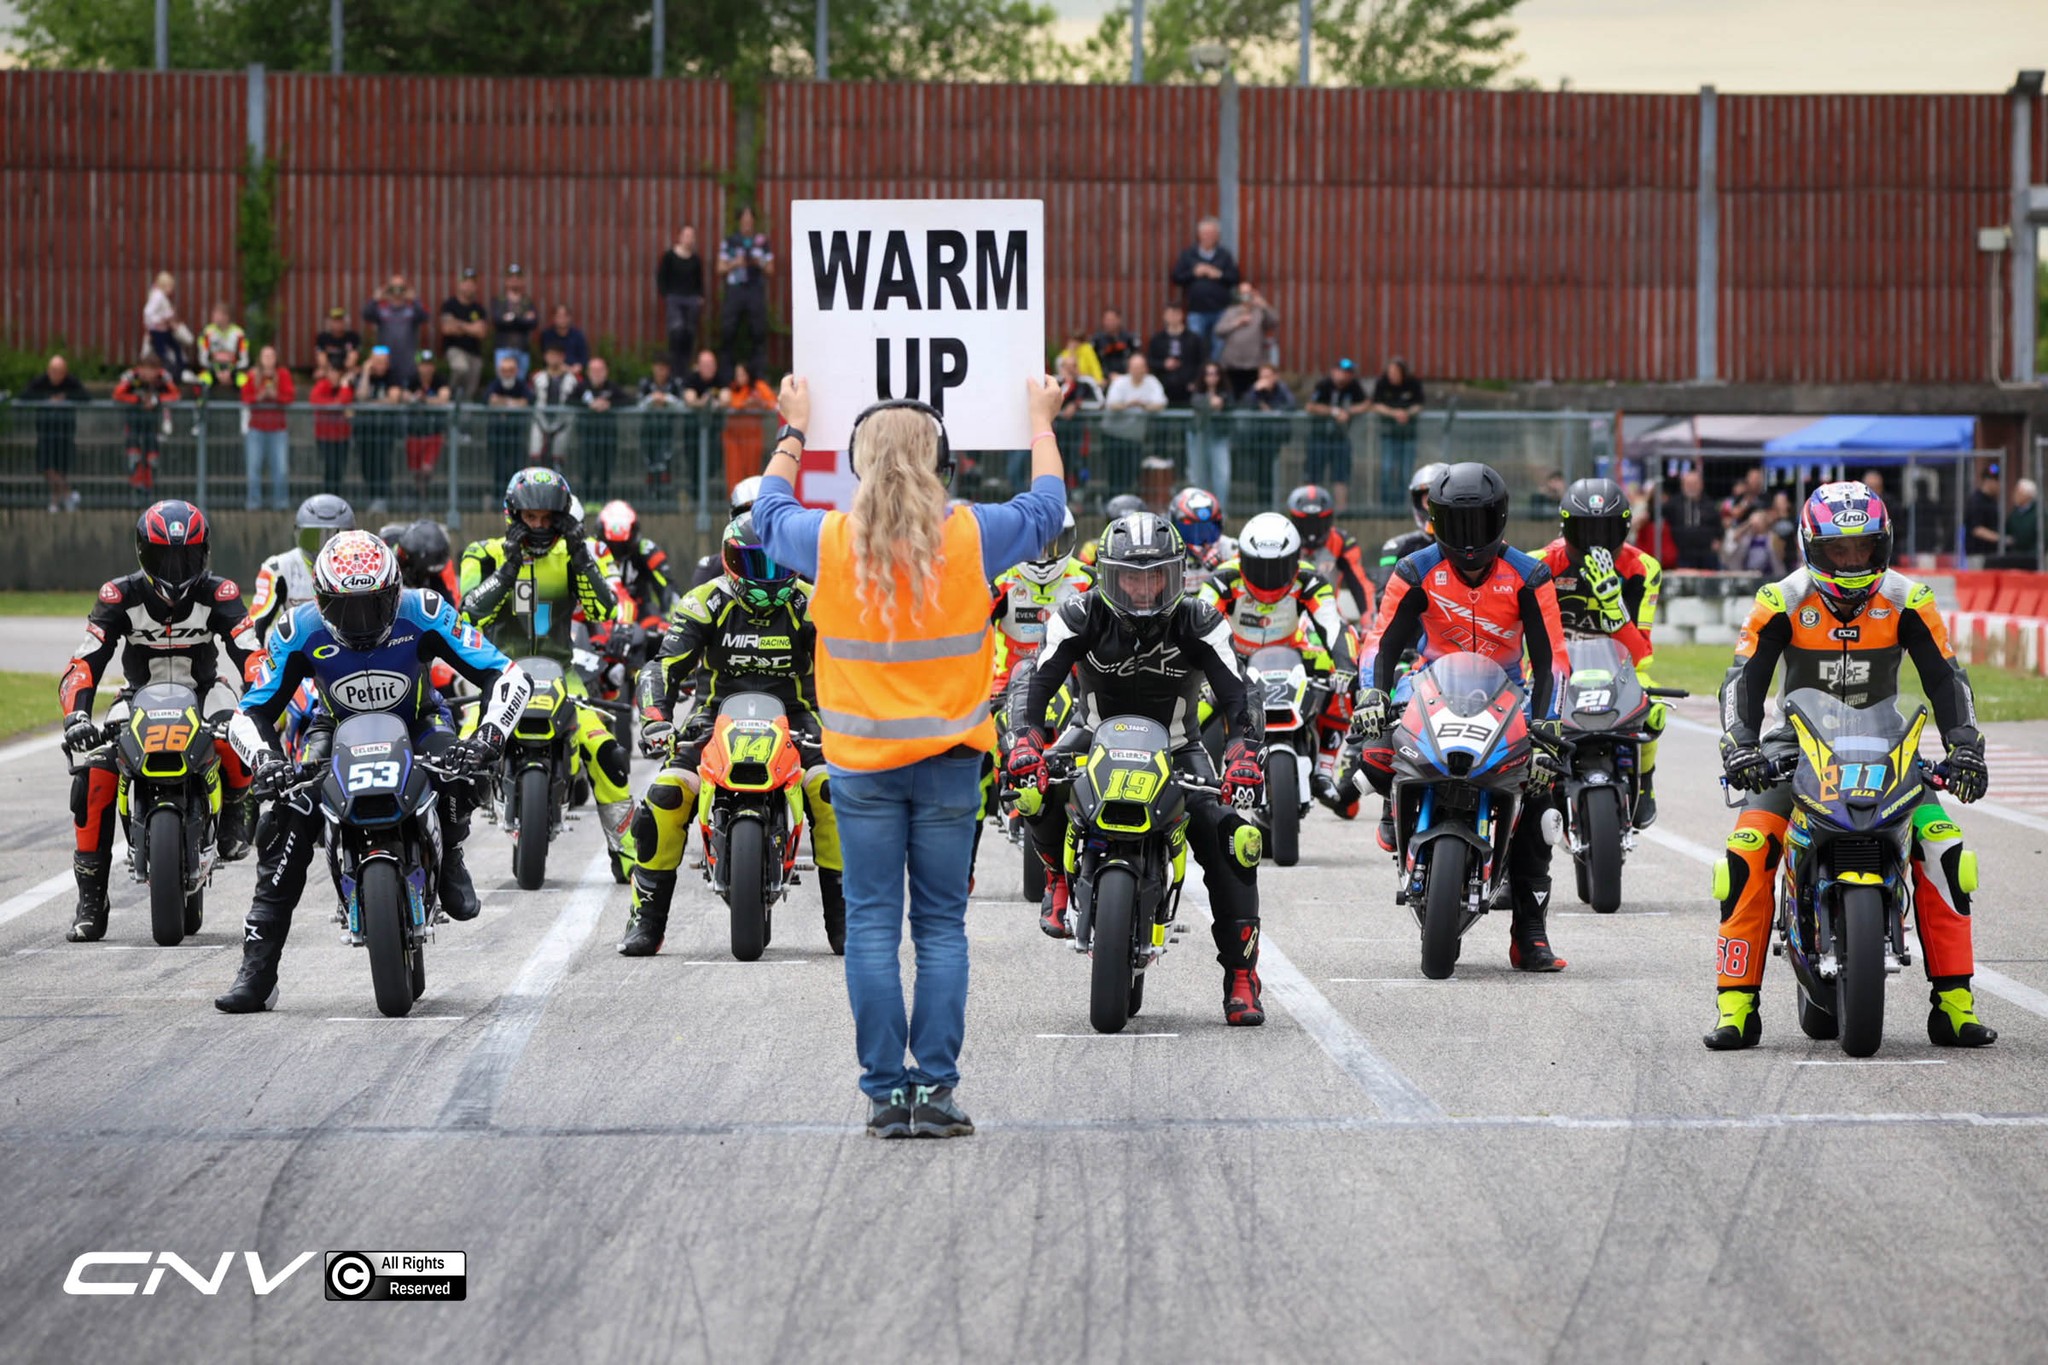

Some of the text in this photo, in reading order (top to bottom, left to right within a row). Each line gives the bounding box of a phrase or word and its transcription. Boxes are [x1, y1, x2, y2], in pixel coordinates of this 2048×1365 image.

[807, 229, 1029, 311] WARM
[876, 337, 969, 418] UP
[1835, 512, 1866, 524] Arai
[342, 576, 372, 588] Arai
[722, 633, 790, 648] MIR RACING
[346, 681, 398, 705] Petrič
[500, 685, 528, 728] GUERILA
[1264, 684, 1289, 709] 2
[1576, 689, 1612, 709] 21
[144, 724, 191, 754] 26
[731, 736, 773, 763] 14
[348, 761, 401, 793] 53
[1102, 769, 1158, 803] 19
